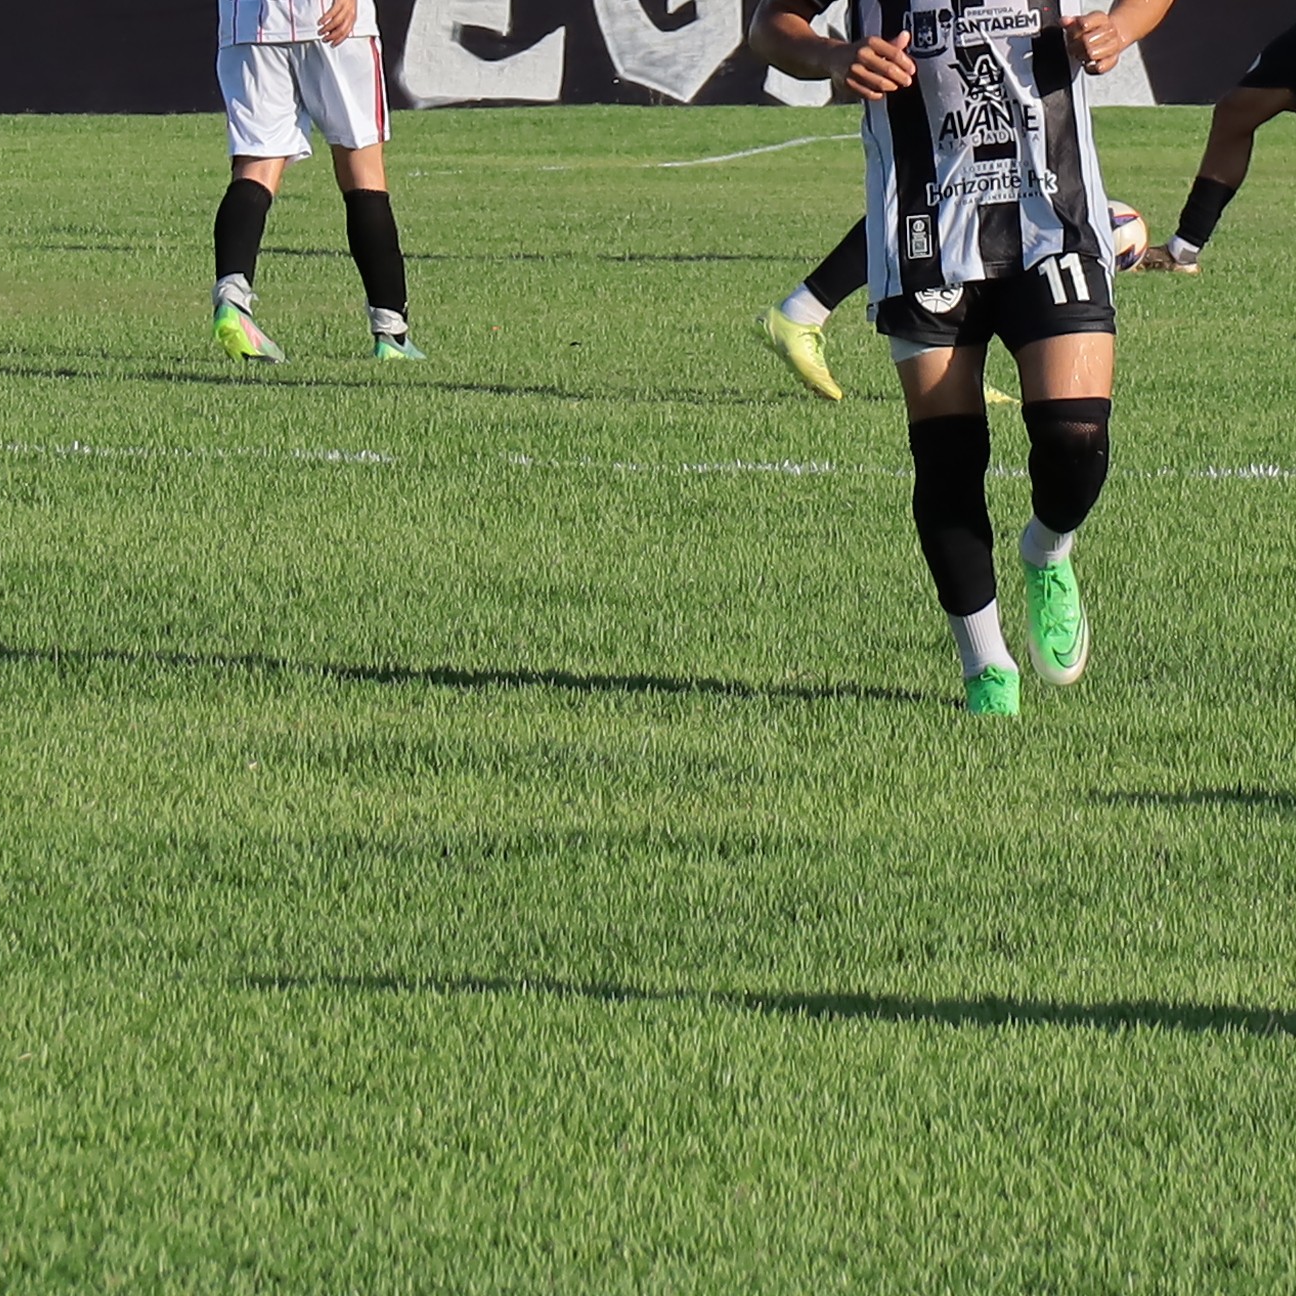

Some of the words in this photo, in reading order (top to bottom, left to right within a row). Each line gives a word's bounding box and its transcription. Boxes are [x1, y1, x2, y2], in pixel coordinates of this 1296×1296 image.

[955, 9, 1039, 35] ANTARÉM
[937, 98, 1040, 142] AVANE
[928, 172, 1022, 204] Horizonte
[1027, 169, 1058, 192] Prk
[1038, 252, 1090, 305] 11
